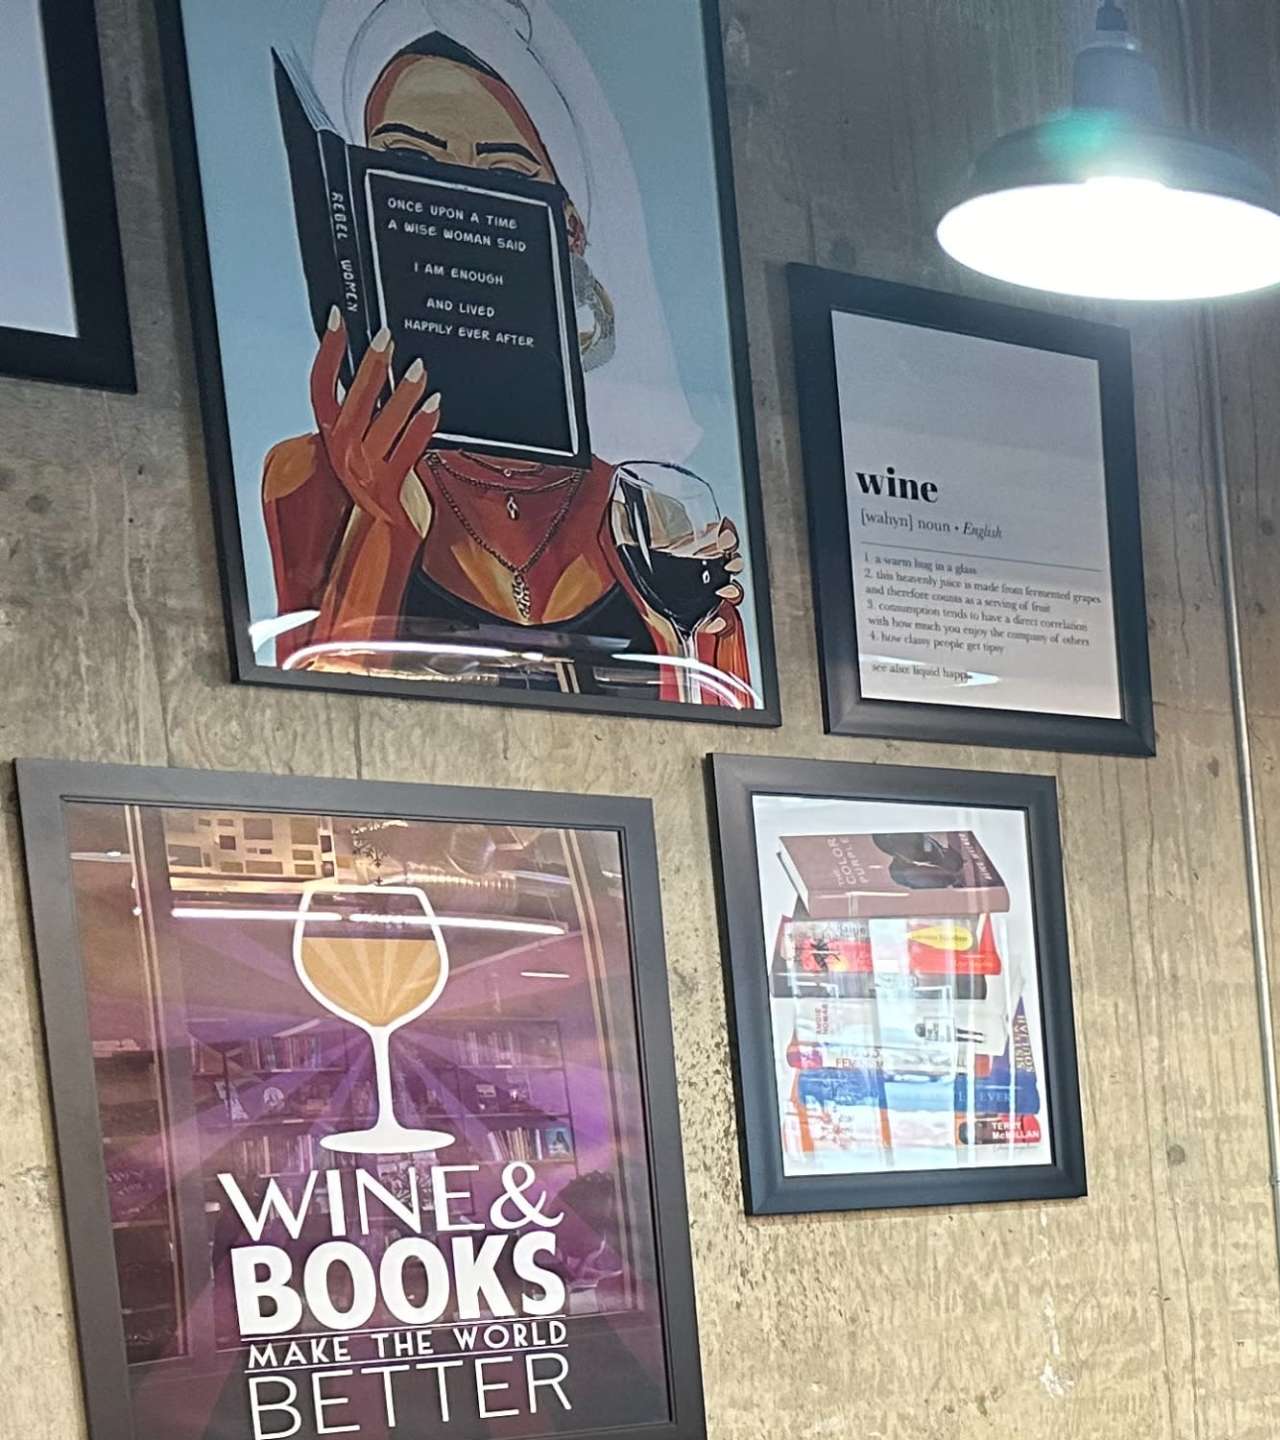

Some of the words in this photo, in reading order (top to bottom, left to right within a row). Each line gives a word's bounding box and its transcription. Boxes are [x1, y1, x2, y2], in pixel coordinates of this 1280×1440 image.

[387, 197, 424, 213] ONCE
[430, 205, 464, 220] UPON
[470, 212, 480, 224] A
[486, 215, 518, 230] TIME
[388, 219, 398, 230] A
[404, 222, 438, 236] WISE
[443, 229, 492, 247] WOMAN
[496, 237, 527, 252] SAID
[331, 191, 348, 240] REBEL
[340, 259, 358, 312] WOMEN
[414, 262, 419, 273] I
[424, 263, 445, 277] AM
[450, 267, 504, 285] ENOUGH
[426, 298, 454, 311] AND
[459, 303, 496, 318] LIVED
[404, 319, 453, 335] HAPPILY
[458, 327, 490, 341] EVER
[495, 332, 535, 347] AFTER
[855, 466, 939, 503] wine
[917, 519, 951, 533] noun
[963, 521, 1003, 540] English
[883, 557, 912, 567] warm
[865, 585, 885, 596] and
[984, 599, 1018, 612] serving
[1018, 601, 1029, 611] of
[974, 583, 1000, 593] made
[1001, 584, 1024, 596] from
[1024, 587, 1071, 600] fermented
[981, 611, 1003, 622] have
[892, 617, 913, 628] how
[914, 621, 942, 632] much
[943, 625, 961, 636] you
[989, 627, 1005, 638] the
[1049, 634, 1059, 643] of
[933, 638, 965, 650] people
[966, 642, 981, 652] get
[872, 663, 888, 672] see
[827, 837, 857, 885] COLOR
[230, 1230, 566, 1336] BOOKS
[248, 1338, 353, 1369] MAKE
[370, 1328, 436, 1359] THE
[451, 1319, 569, 1352] WORLD
